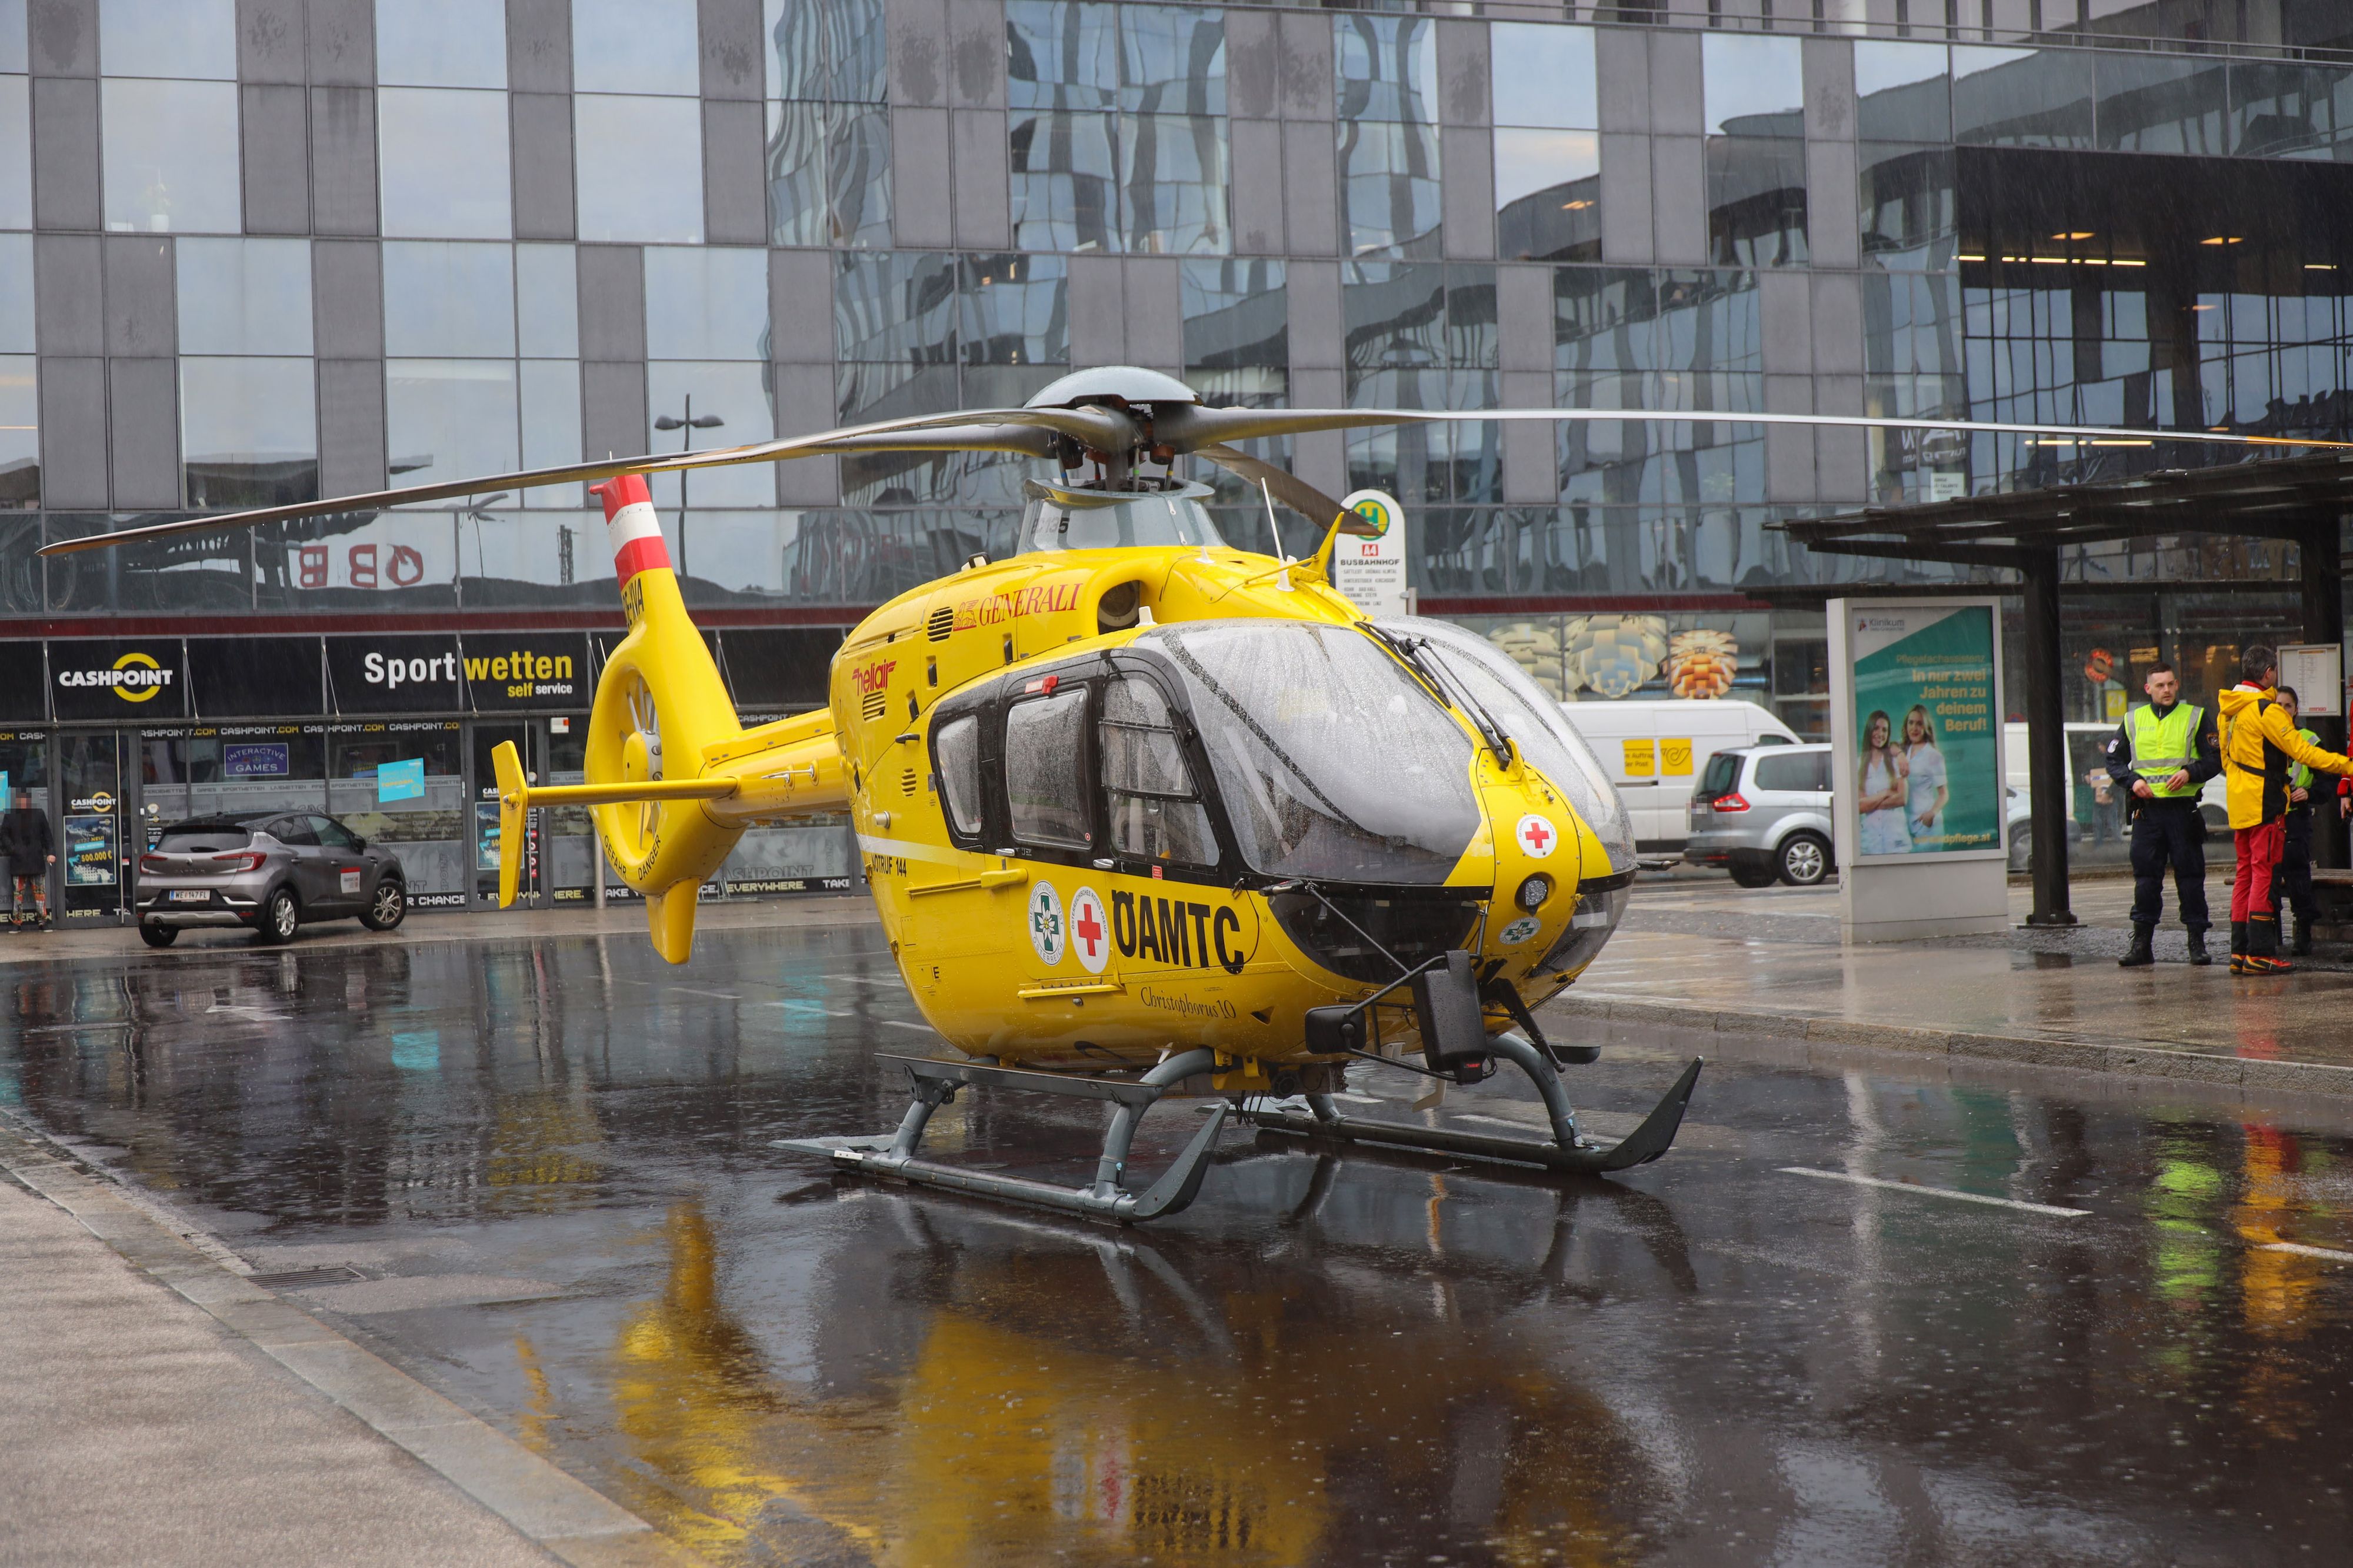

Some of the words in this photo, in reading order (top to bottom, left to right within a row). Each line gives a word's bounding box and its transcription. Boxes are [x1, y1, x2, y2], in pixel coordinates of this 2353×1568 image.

[1363, 545, 1377, 555] A4
[979, 583, 1083, 626] GENERALI
[1896, 654, 1985, 665] Pflegefachassistenz
[364, 652, 456, 689] Sport
[464, 651, 572, 680] wetten
[1912, 670, 1925, 682] In
[1928, 672, 1950, 682] nur
[1954, 668, 1986, 681] zwei
[59, 670, 173, 686] CASHPOINT
[852, 659, 896, 696] heliair
[508, 683, 533, 698] self
[535, 683, 573, 695] service
[1920, 686, 1967, 699] Jahren
[1969, 688, 1986, 698] zu
[1936, 702, 1987, 715] deinem
[221, 726, 299, 735] CASHPOINT.COM
[389, 722, 459, 731] CASHPOINT.CO
[1945, 718, 1987, 731] Beruf!
[227, 748, 286, 762] INTERACTIVE
[236, 764, 278, 772] GAMES
[71, 798, 116, 806] CASHPOINT
[81, 851, 107, 863] 500.000
[108, 850, 113, 859] €
[604, 835, 627, 880] GEFAHR
[638, 835, 661, 881] DANGER
[871, 854, 892, 875] NOTRUF
[896, 858, 907, 877] 144
[605, 888, 629, 898] AKE
[727, 880, 806, 892] EVERYWHERE.
[1111, 889, 1244, 974] ÖAMTC
[933, 967, 940, 979] E
[1141, 986, 1219, 1018] Christophorus
[1217, 1000, 1237, 1019] 10
